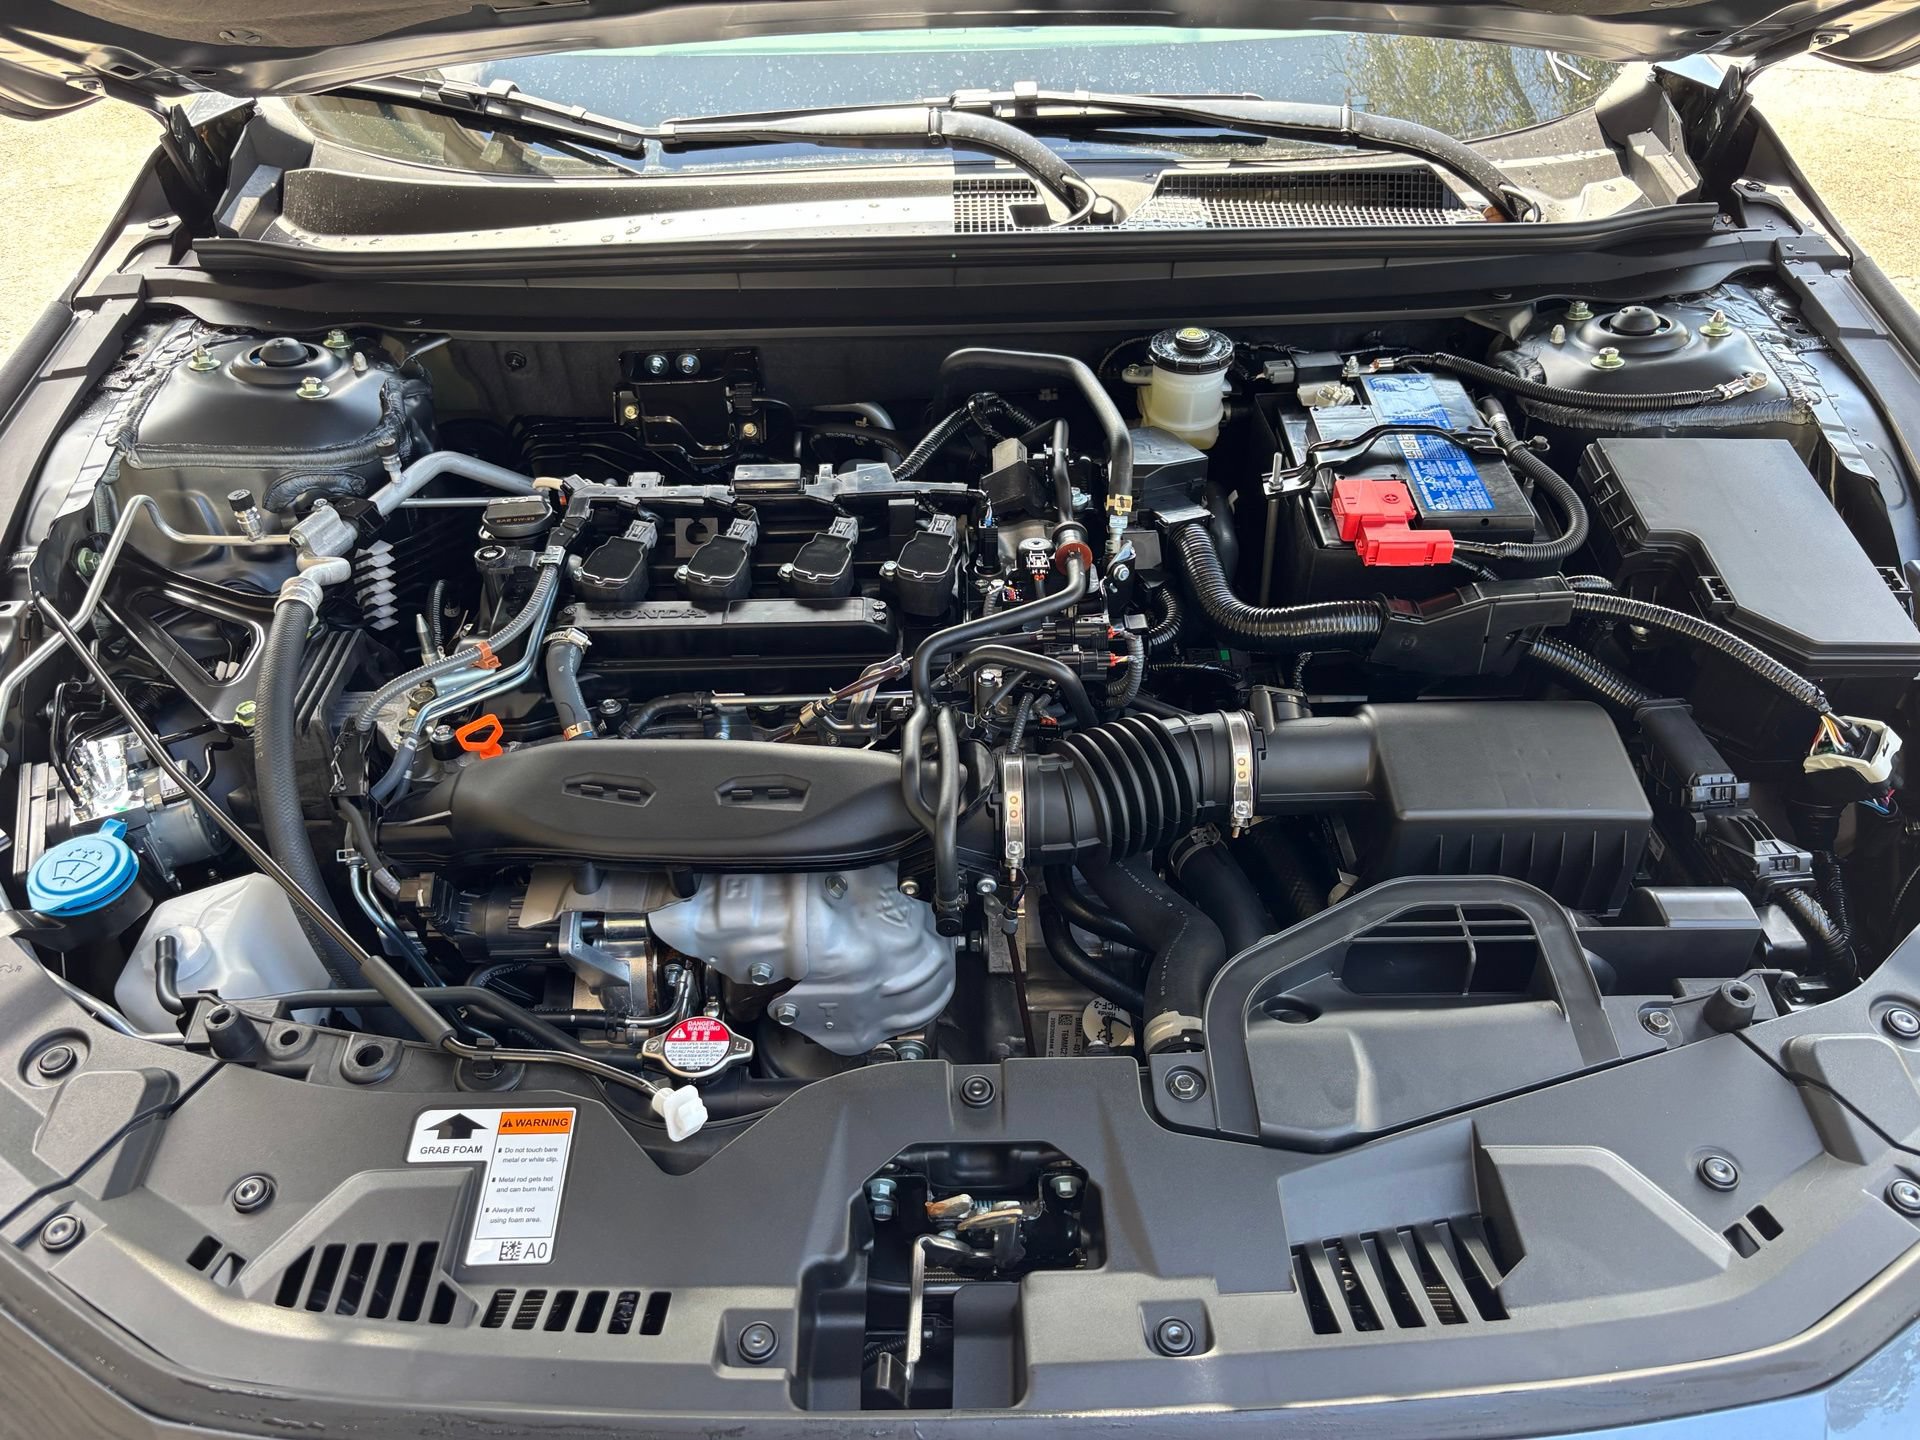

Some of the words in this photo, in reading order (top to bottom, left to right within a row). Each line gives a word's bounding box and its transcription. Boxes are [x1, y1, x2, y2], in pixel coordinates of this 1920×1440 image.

[590, 608, 707, 620] HONDA
[516, 1118, 568, 1127] WARNING
[420, 1146, 450, 1154] GRAB
[452, 1146, 483, 1154] FOAM
[523, 1242, 548, 1259] A0
